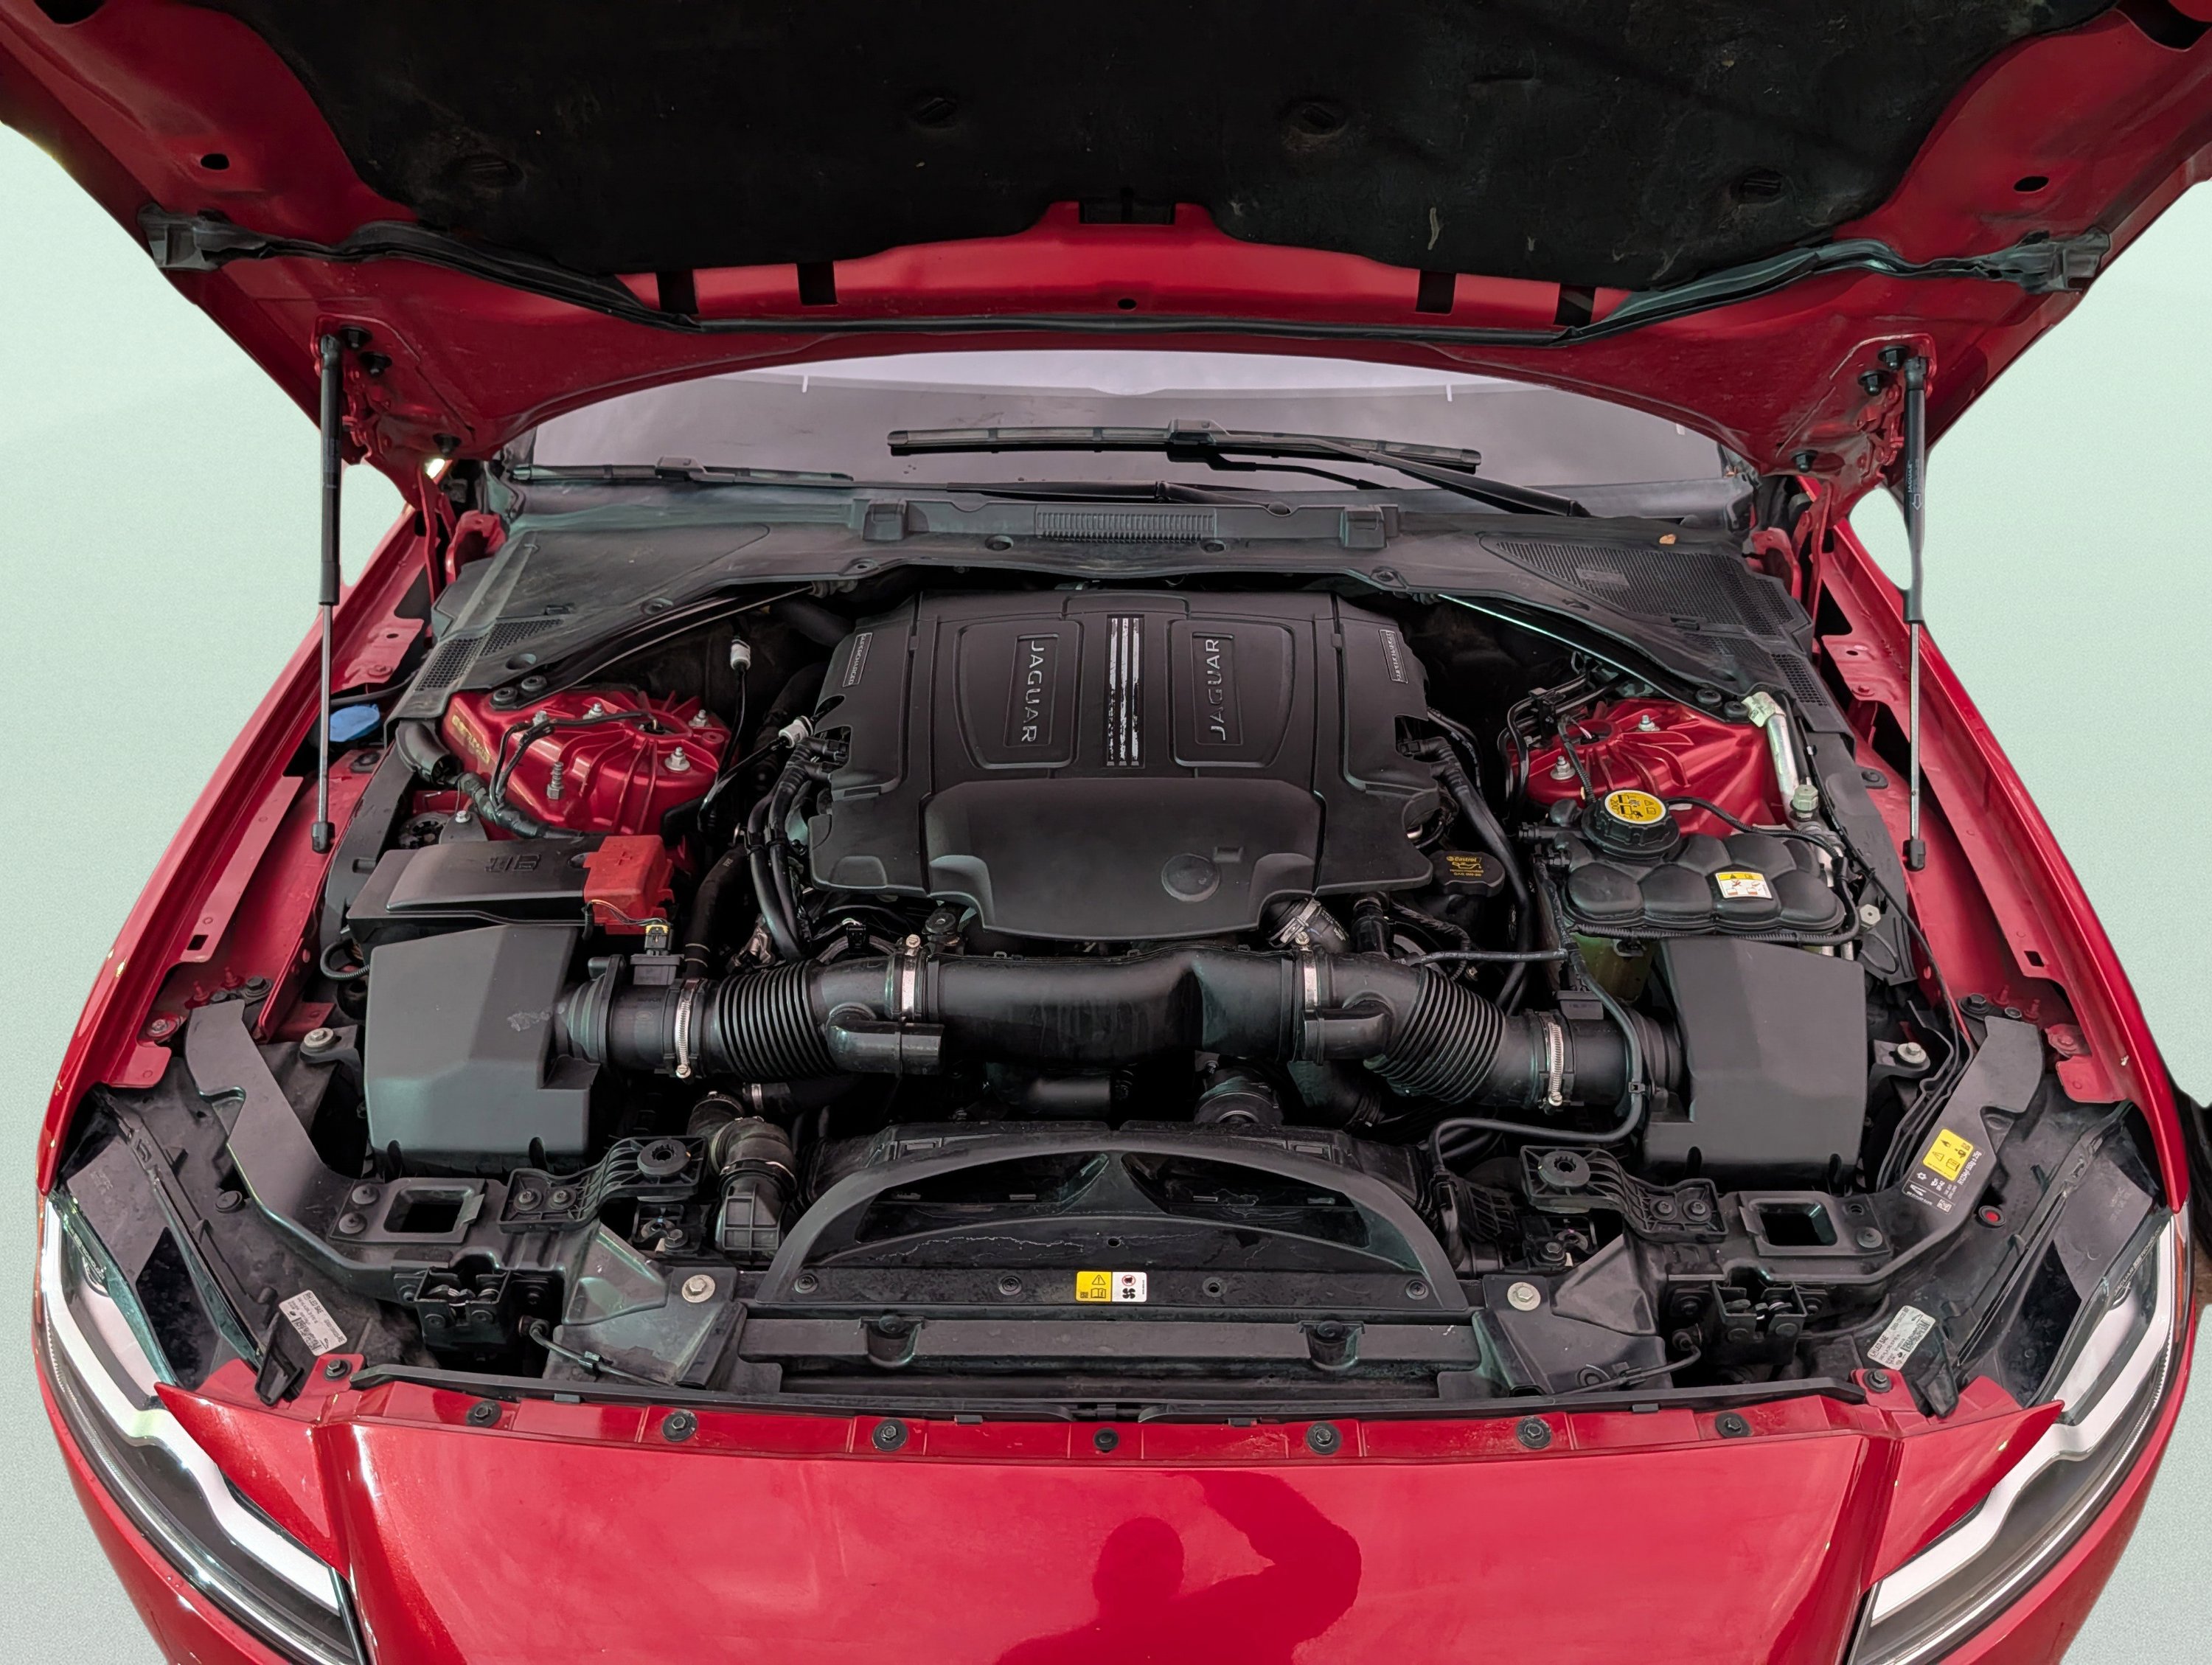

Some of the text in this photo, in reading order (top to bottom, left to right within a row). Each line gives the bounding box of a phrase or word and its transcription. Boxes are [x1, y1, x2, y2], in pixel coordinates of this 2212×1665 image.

[1021, 640, 1044, 742] JAGUAR
[1205, 639, 1225, 741] JAGUAR
[309, 1297, 318, 1307] LED
[1874, 1341, 1882, 1352] LED
[1879, 1334, 1888, 1344] SAE
